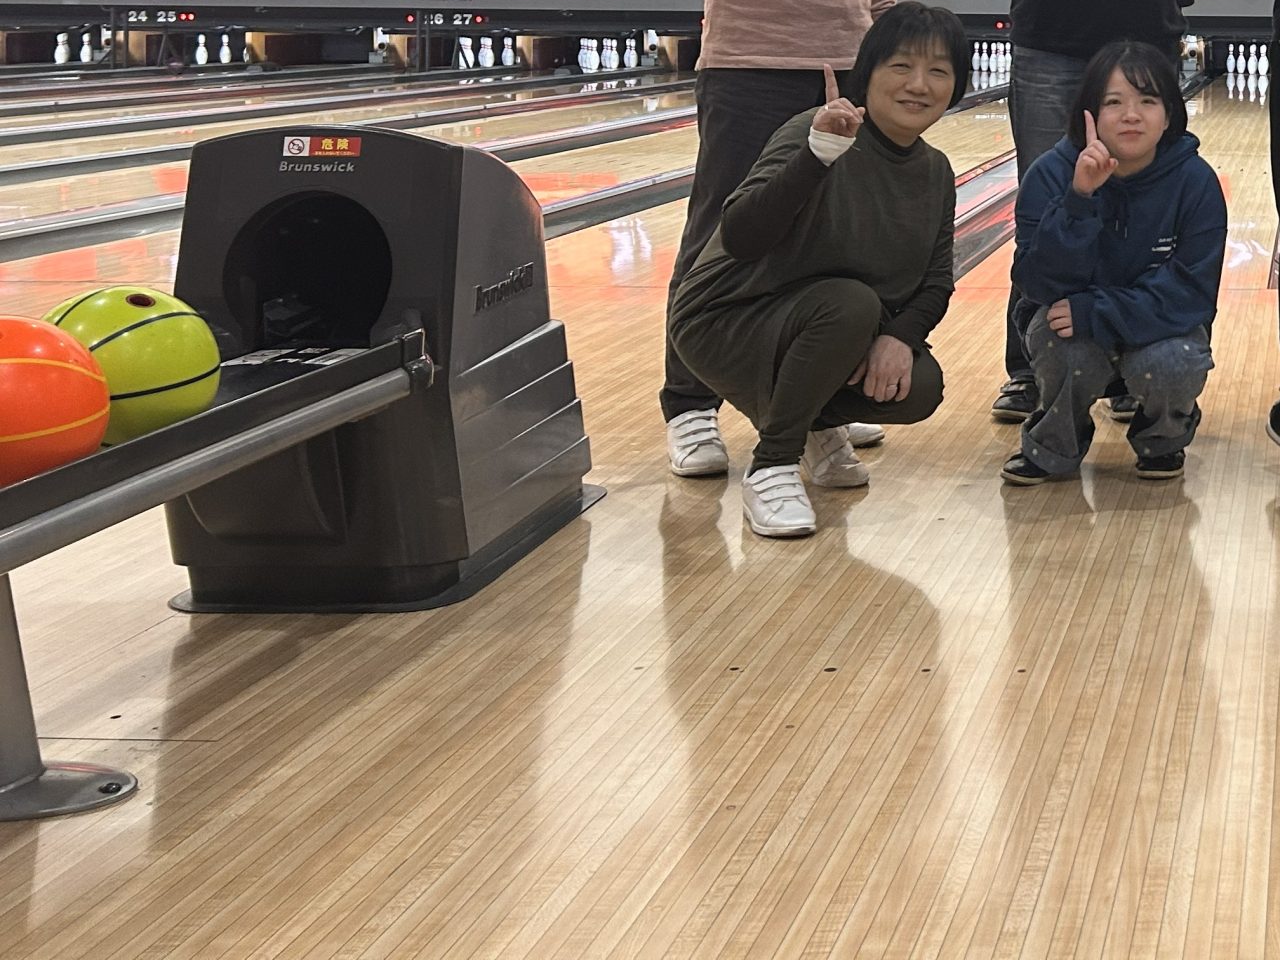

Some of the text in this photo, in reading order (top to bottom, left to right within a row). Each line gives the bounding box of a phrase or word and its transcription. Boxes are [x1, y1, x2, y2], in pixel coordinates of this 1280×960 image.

[128, 10, 177, 22] 24 25
[453, 14, 473, 25] 27
[321, 138, 349, 150] 危険
[279, 161, 355, 172] Brunswick
